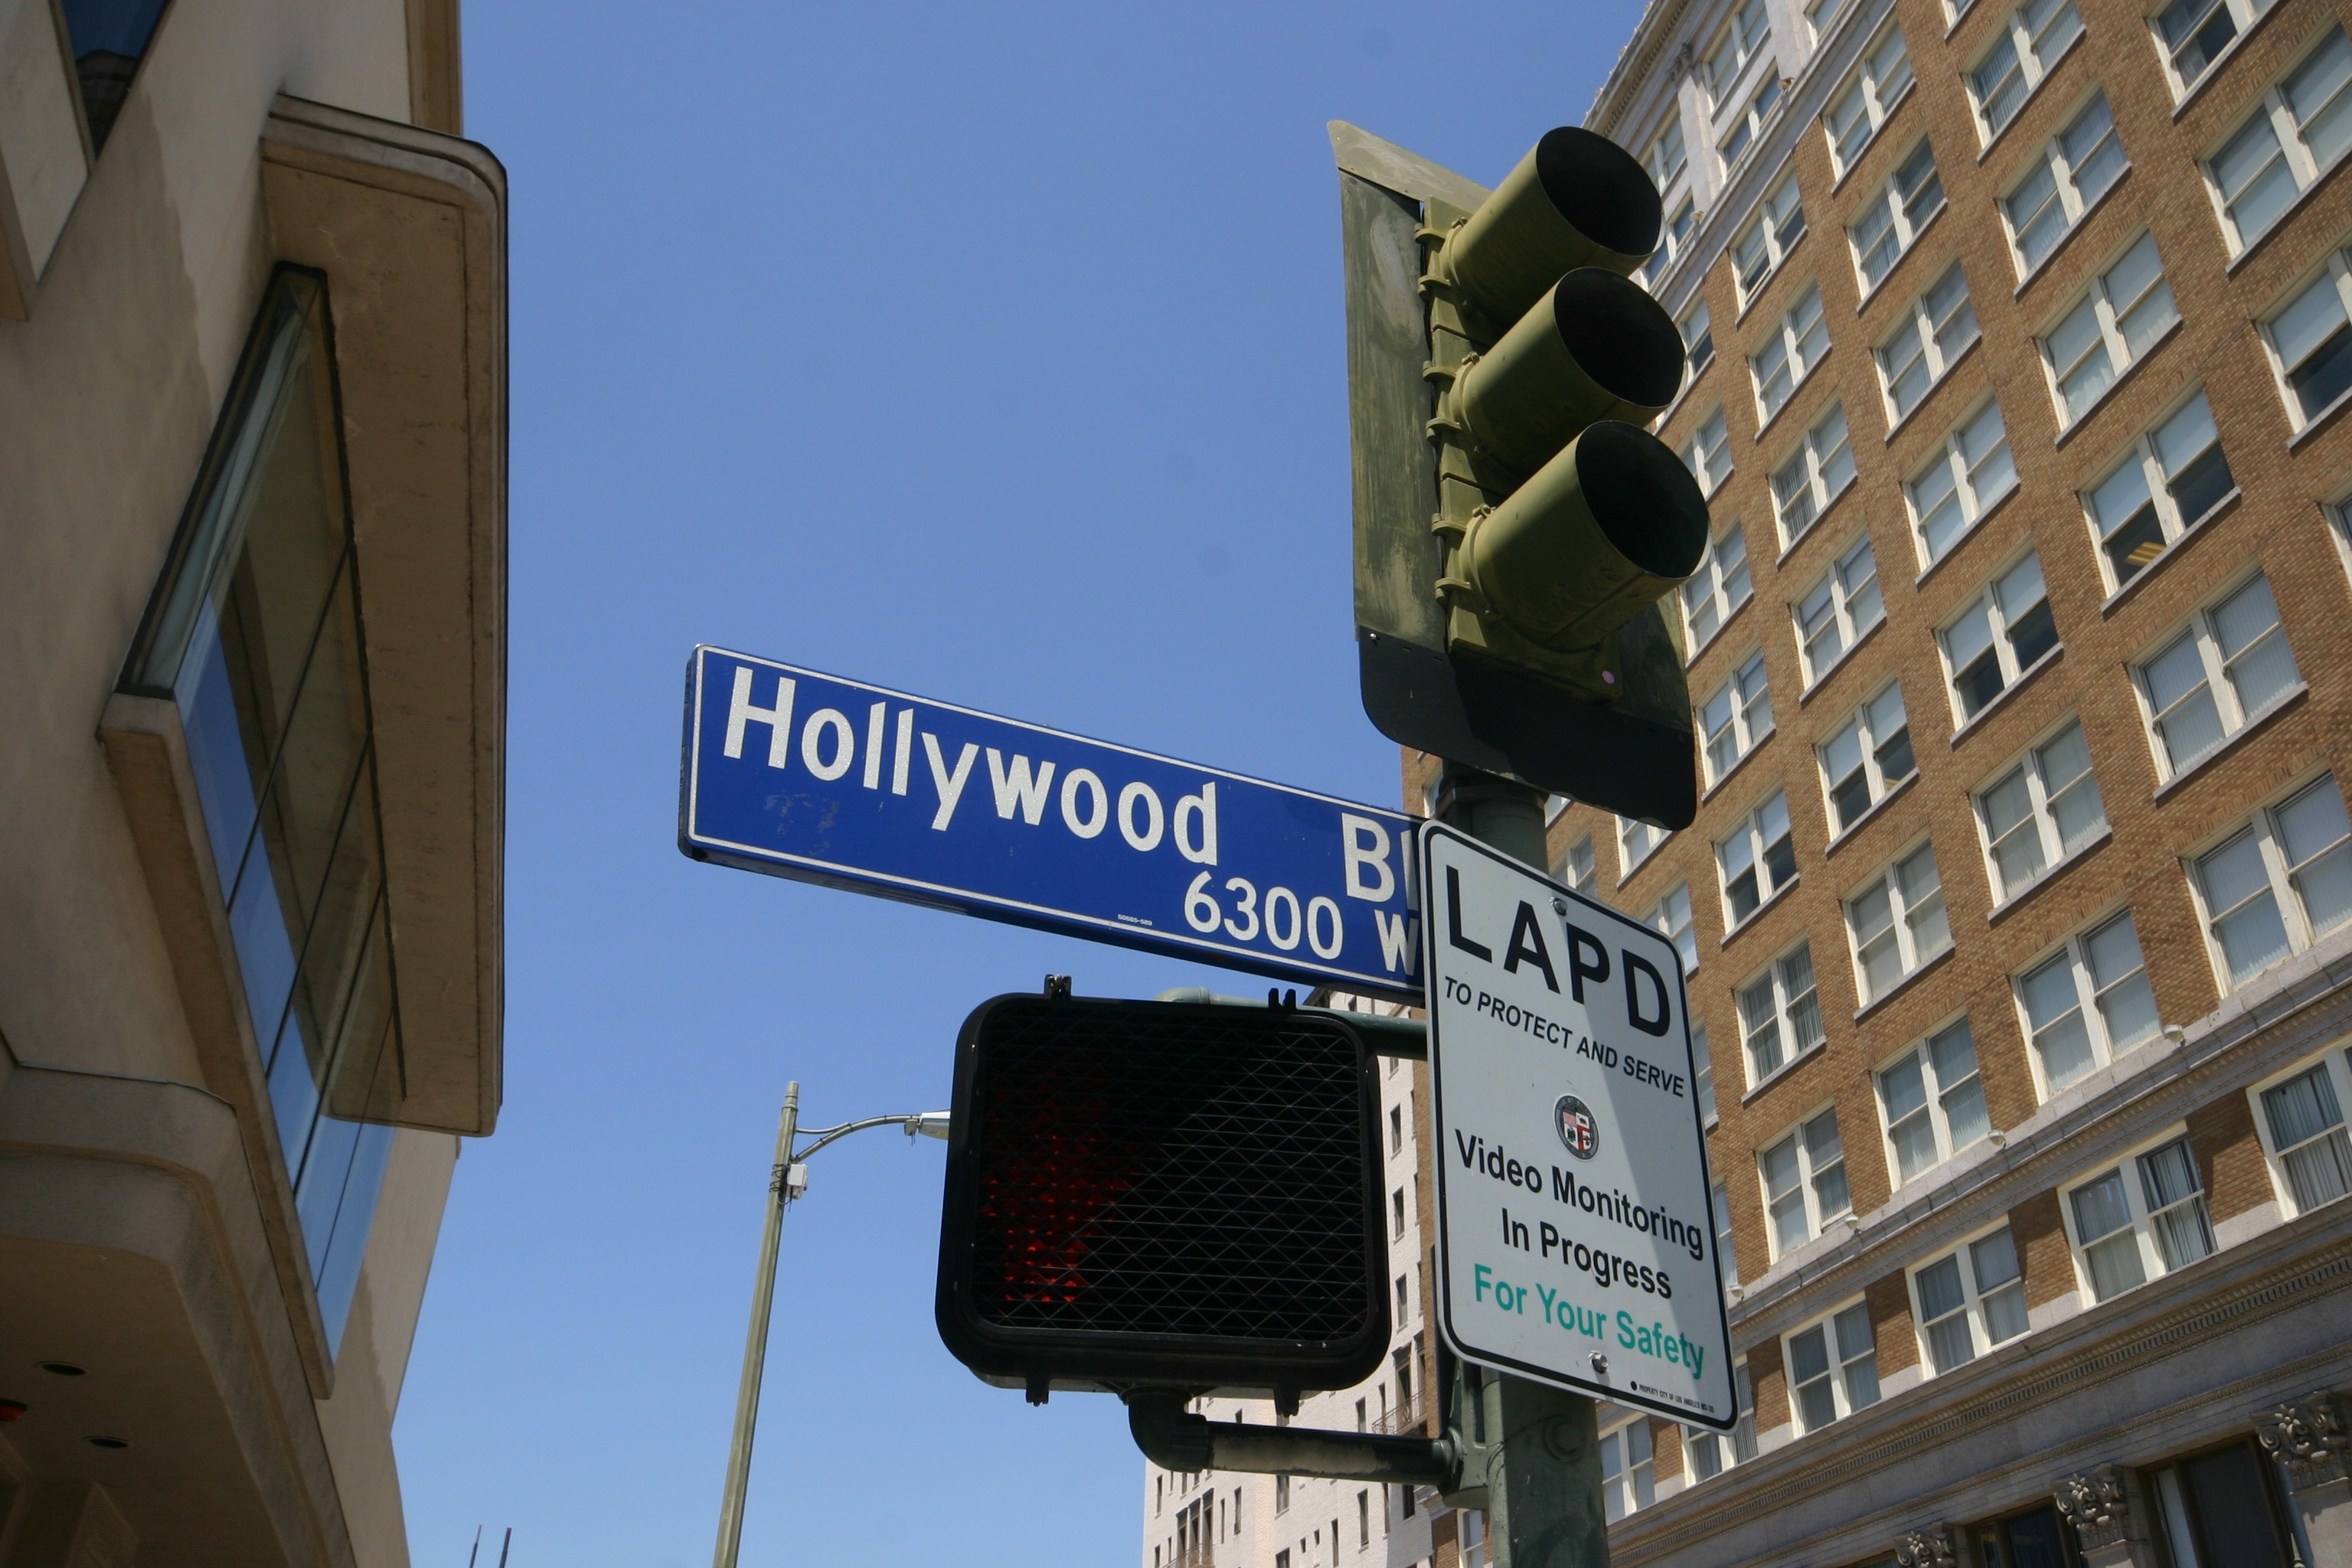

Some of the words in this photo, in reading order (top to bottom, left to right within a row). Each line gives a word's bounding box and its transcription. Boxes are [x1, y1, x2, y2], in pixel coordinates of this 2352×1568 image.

[724, 666, 1217, 866] Hollywood
[1184, 871, 1343, 960] 6300
[1374, 910, 1419, 976] W
[1446, 865, 1671, 1037] LAPD
[1445, 976, 1472, 1005] TO
[1478, 991, 1573, 1049] PROTECT
[1576, 1037, 1617, 1068] AND
[1623, 1056, 1684, 1098] SERVE
[1455, 1129, 1542, 1193] Video
[1552, 1166, 1704, 1261] Monitoring
[1501, 1208, 1530, 1252] In
[1540, 1221, 1671, 1299] Progress
[1474, 1263, 1527, 1315] For
[1536, 1283, 1607, 1340] Your
[1616, 1310, 1704, 1380] Safety
